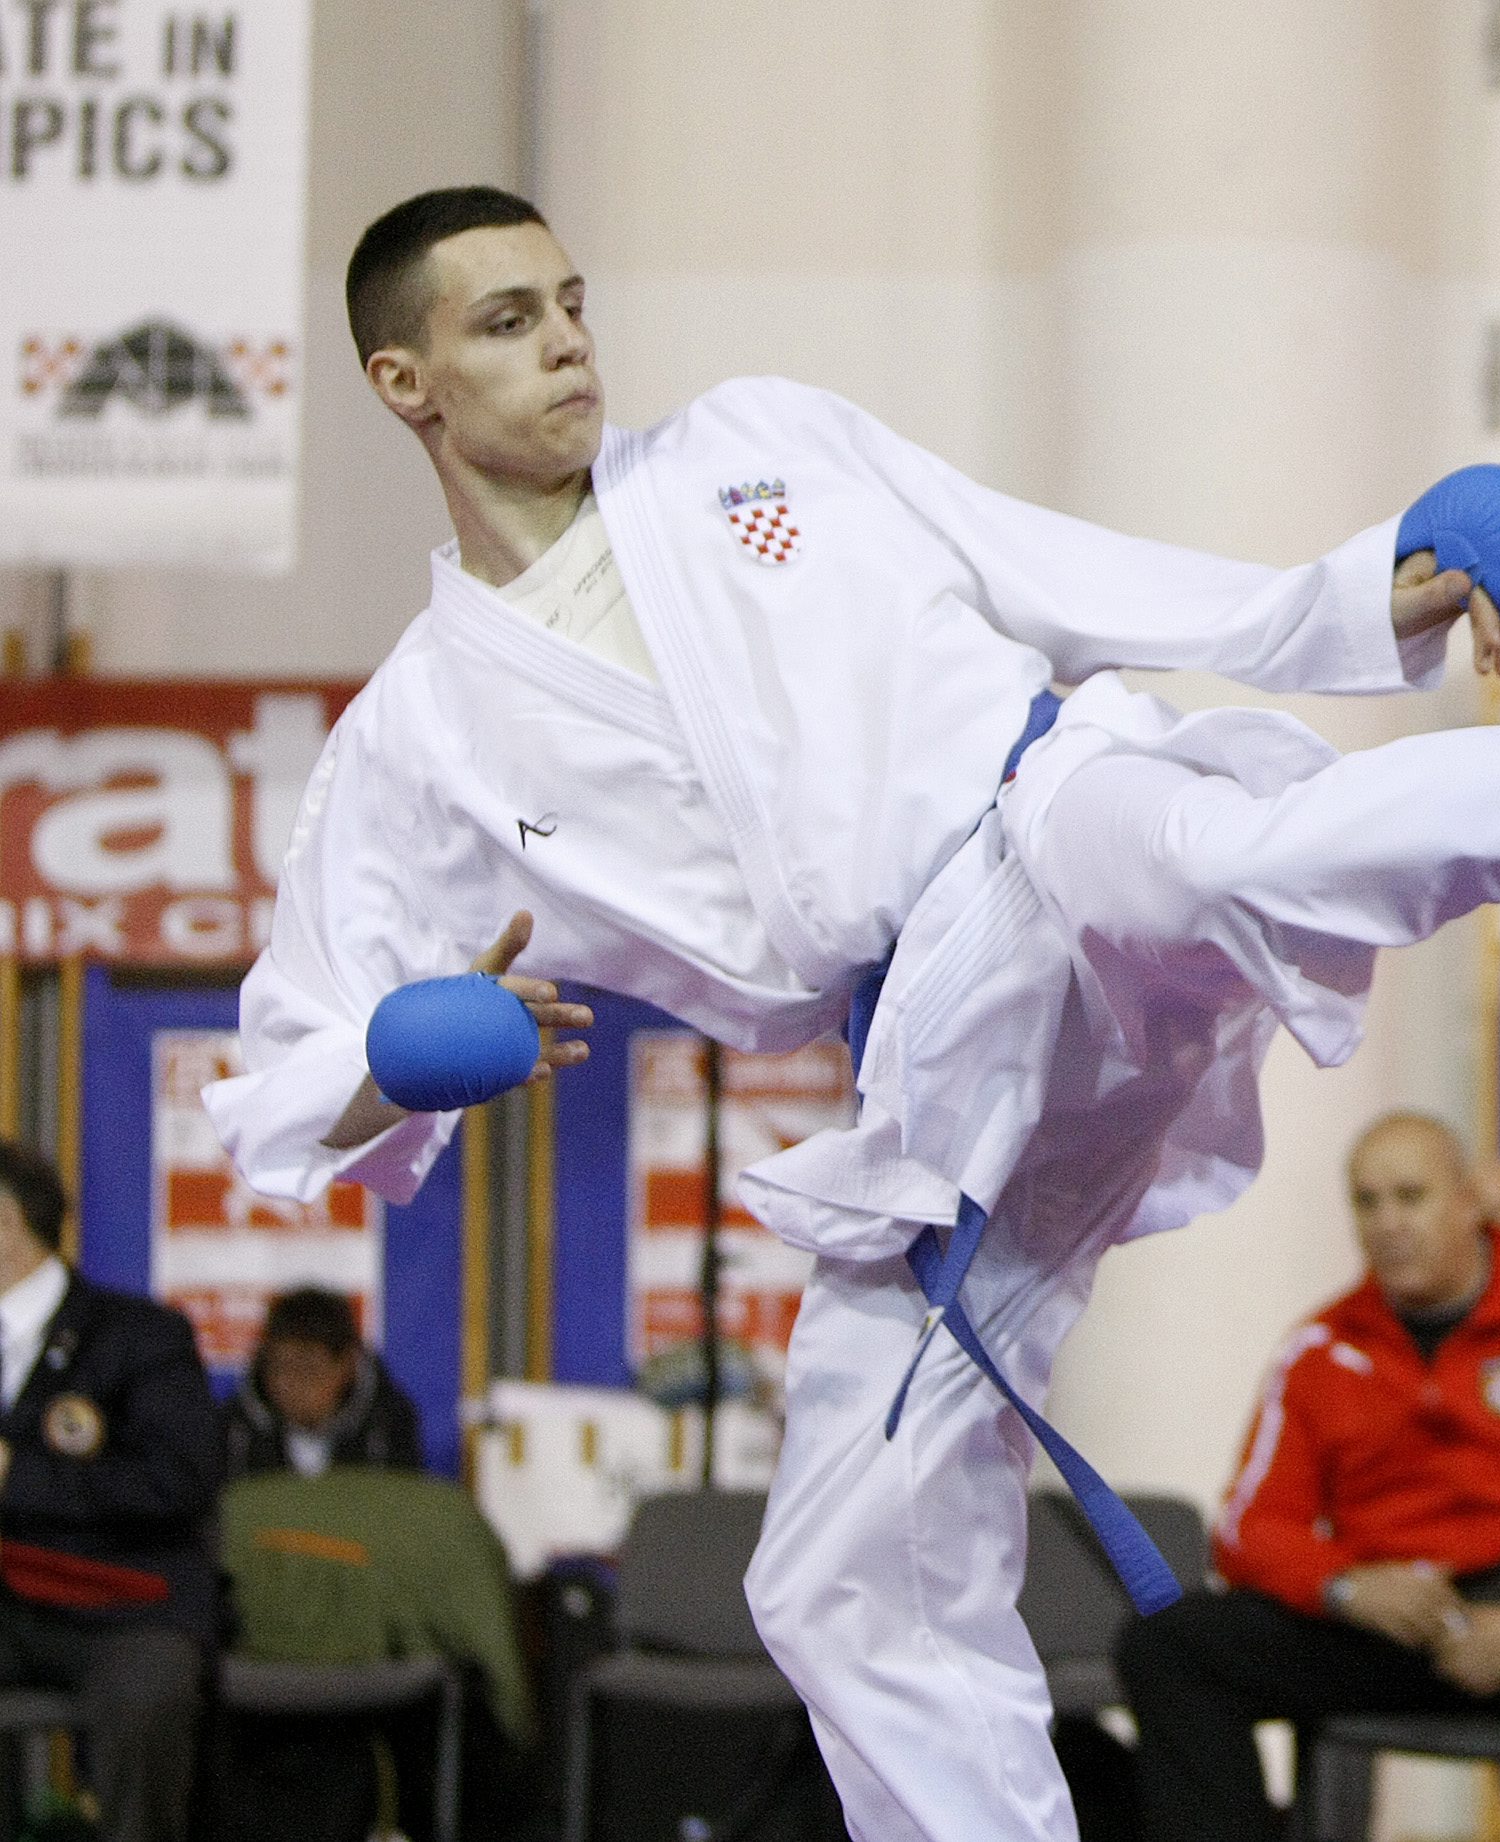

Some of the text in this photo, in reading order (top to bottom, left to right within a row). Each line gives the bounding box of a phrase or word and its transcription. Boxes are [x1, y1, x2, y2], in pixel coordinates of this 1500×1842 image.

[0, 0, 236, 77] TE IN
[0, 895, 128, 953] IX
